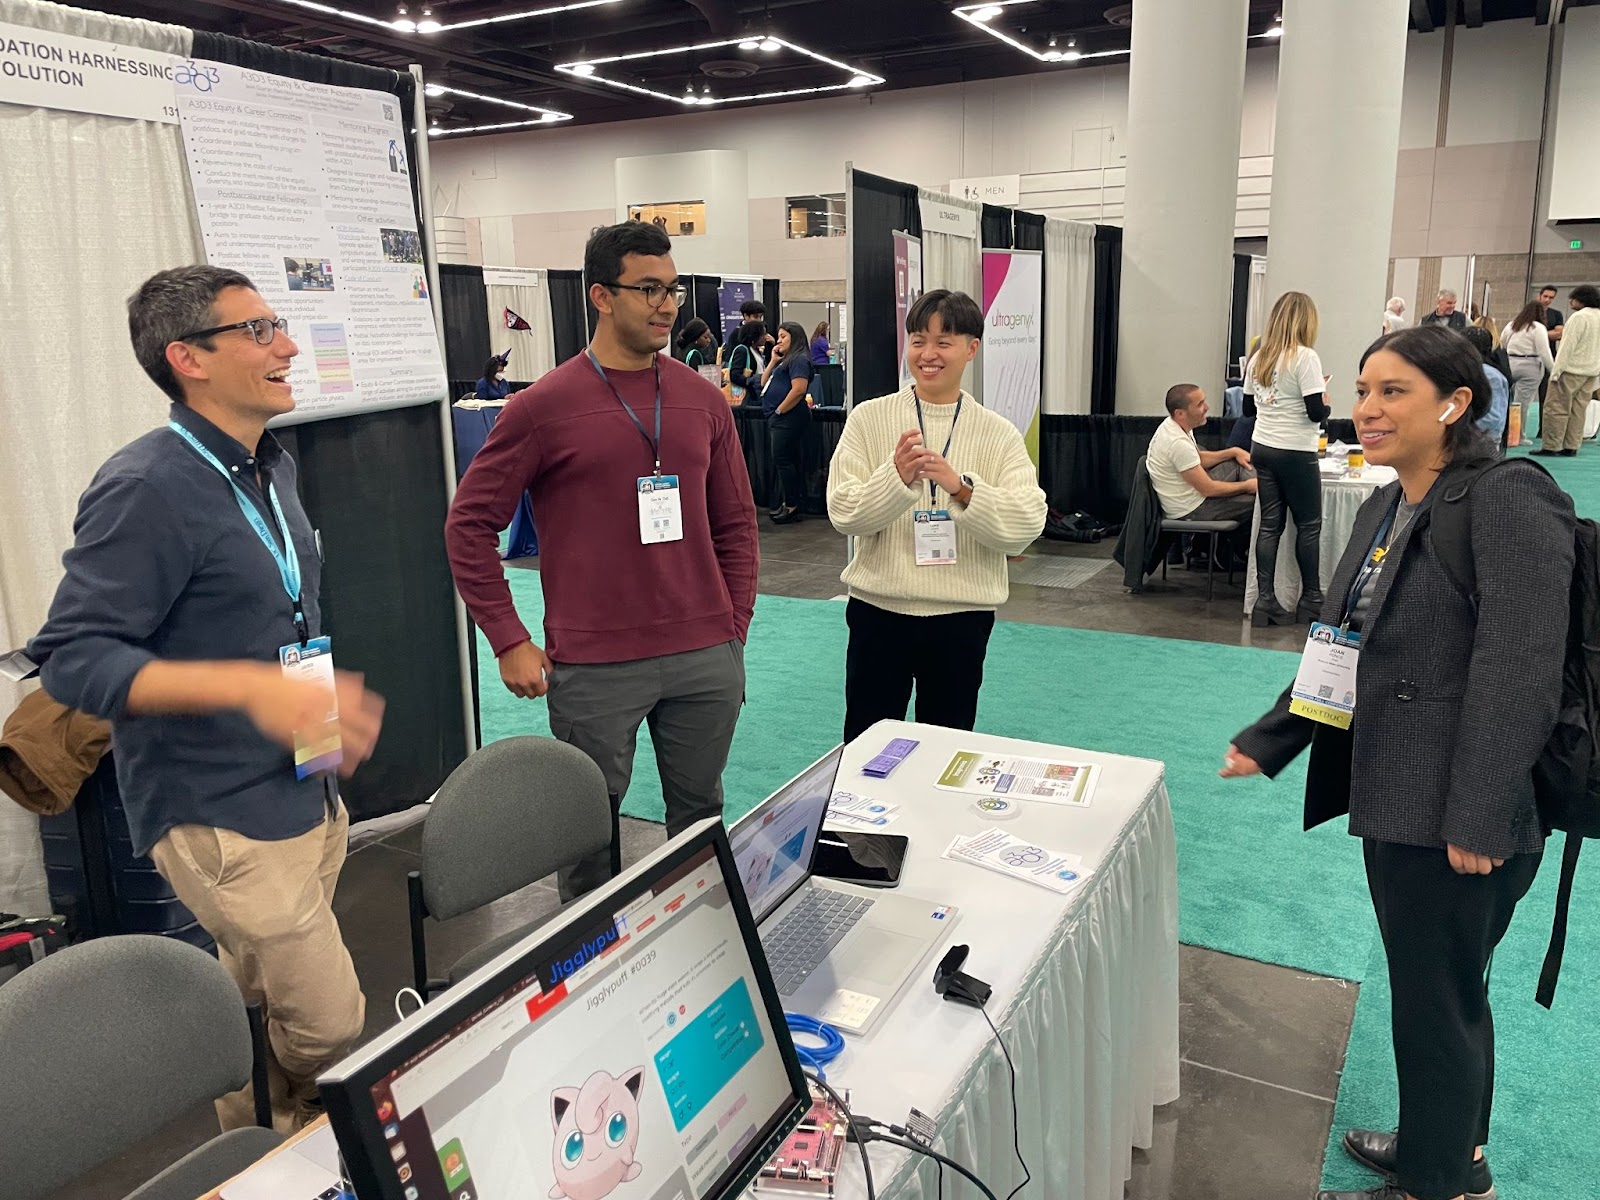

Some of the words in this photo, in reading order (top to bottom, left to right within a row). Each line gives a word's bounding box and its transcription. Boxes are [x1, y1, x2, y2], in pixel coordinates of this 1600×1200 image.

[0, 61, 84, 87] OLUTION
[69, 50, 174, 81] HARNESSING
[240, 71, 266, 84] A3D3
[267, 76, 292, 89] Equity
[293, 81, 301, 89] &
[302, 83, 329, 95] Career
[330, 88, 363, 101] Activities
[189, 100, 212, 110] A3D3
[214, 102, 235, 113] Equity
[237, 105, 243, 113] &
[244, 106, 266, 116] Career
[268, 109, 303, 121] Committee
[217, 189, 276, 202] Postbaccalaureate
[985, 187, 1005, 195] MEN
[992, 304, 1035, 335] ultragenyx
[989, 337, 1001, 347] Going
[1301, 705, 1344, 723] POSTDOC
[549, 914, 628, 984] Jigglypuff
[587, 972, 629, 1011] Jigglypuff
[631, 950, 657, 974] #0039
